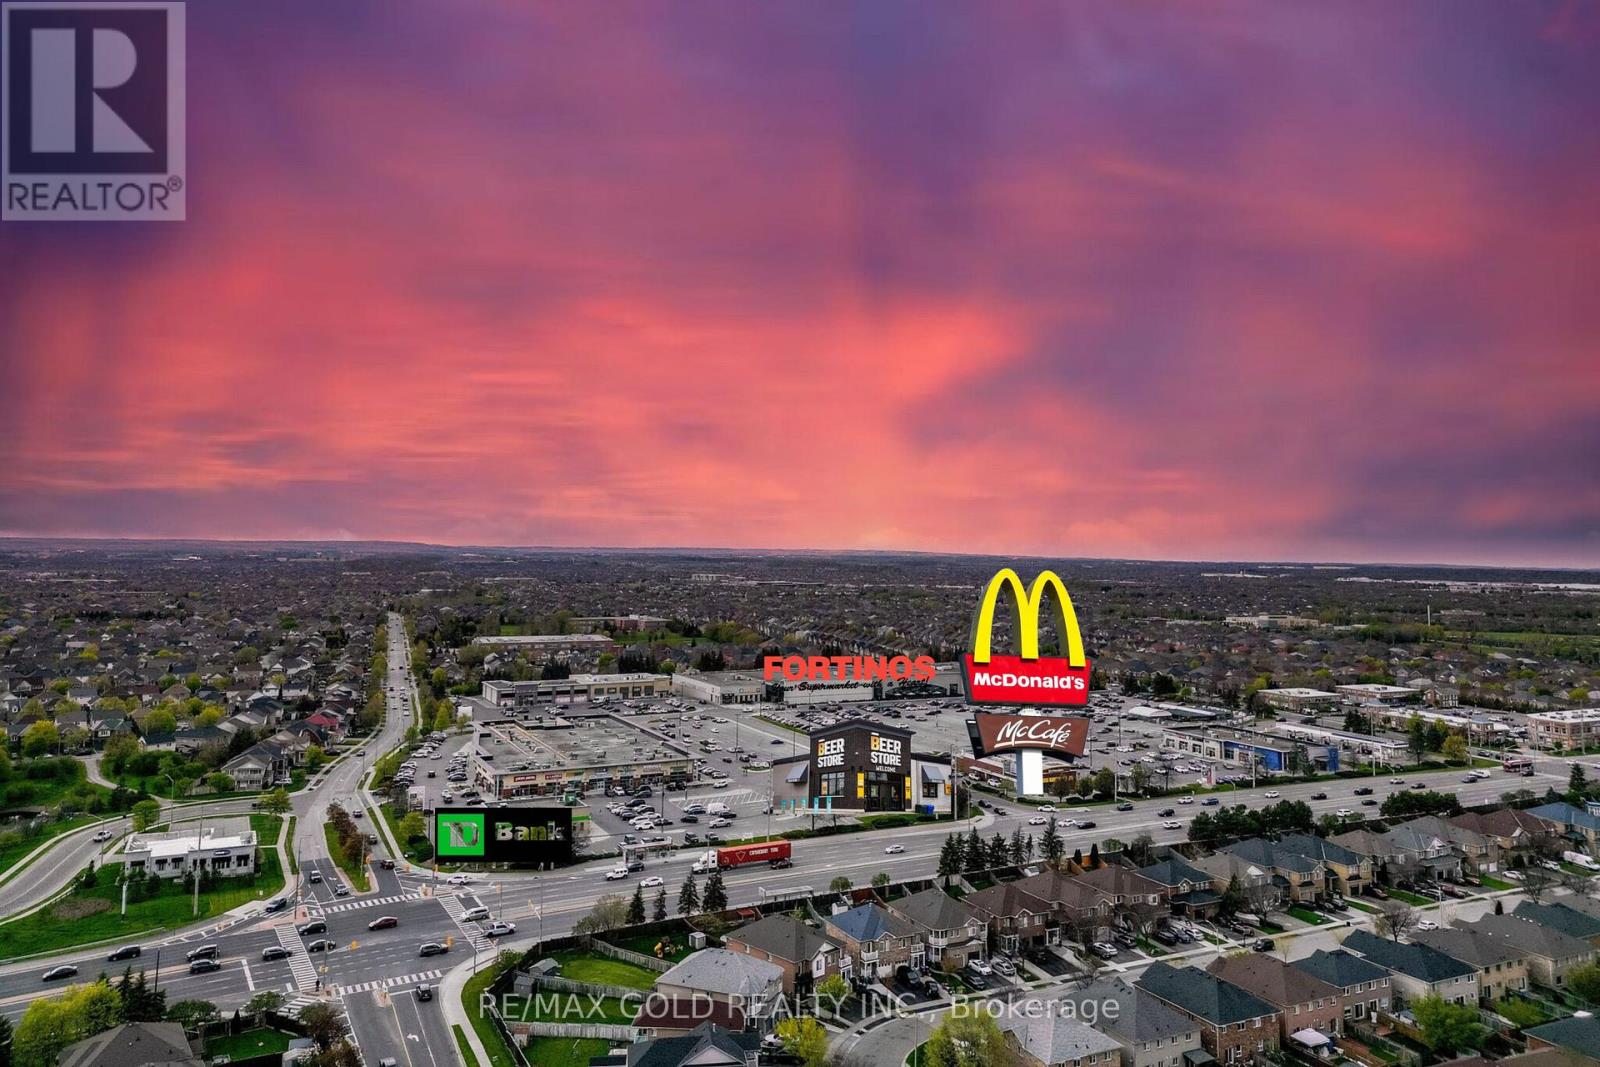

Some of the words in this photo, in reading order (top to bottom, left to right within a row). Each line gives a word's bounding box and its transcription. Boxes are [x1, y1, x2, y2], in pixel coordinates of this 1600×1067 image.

[763, 655, 936, 681] FORTINOS
[798, 680, 859, 693] Supermarket
[973, 672, 1085, 690] McDonald's
[996, 719, 1072, 748] McCafé
[818, 738, 845, 756] BEER
[870, 735, 902, 754] BEER
[817, 753, 845, 768] STORE
[870, 751, 902, 766] STORE
[875, 765, 897, 773] WELCOME
[442, 821, 480, 848] TD
[495, 820, 566, 841] Bank
